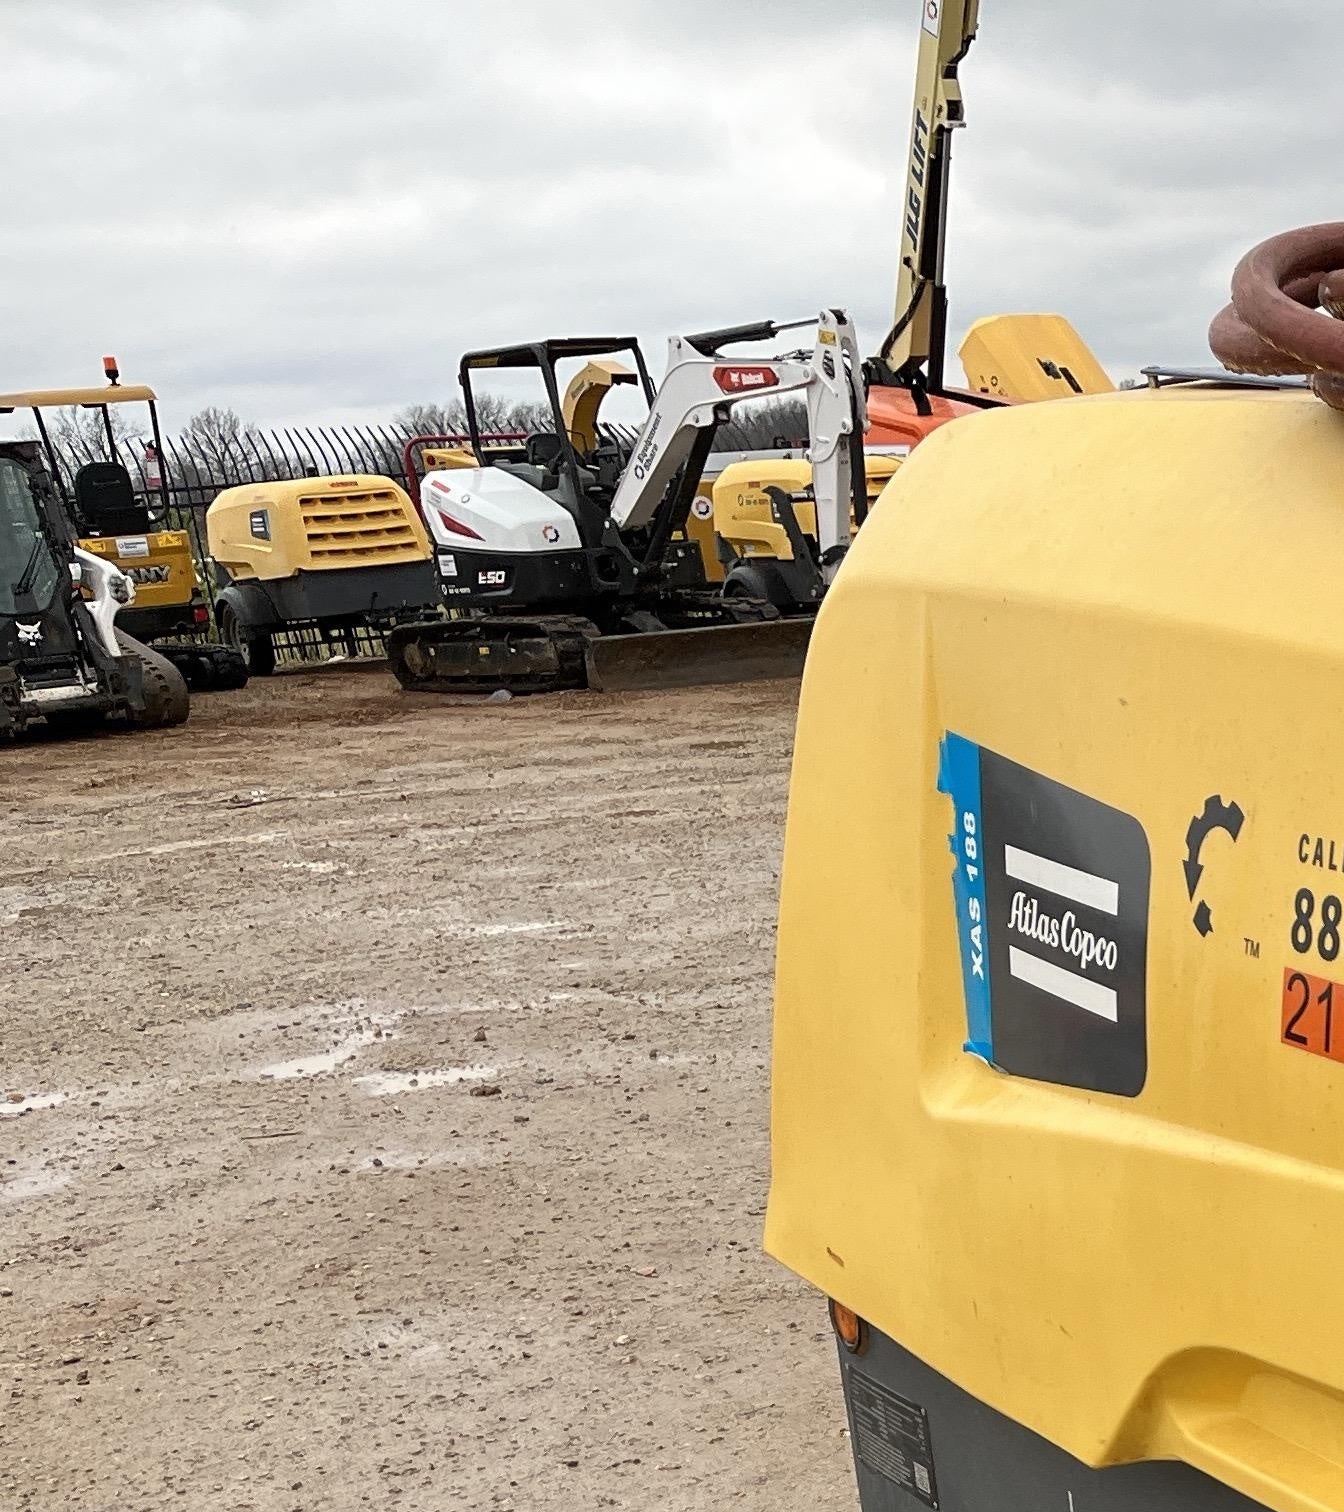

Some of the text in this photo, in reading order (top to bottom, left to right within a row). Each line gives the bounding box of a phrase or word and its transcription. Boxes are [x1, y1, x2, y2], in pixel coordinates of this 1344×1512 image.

[906, 108, 927, 253] JLG LIFT
[124, 564, 170, 583] ANY
[962, 811, 985, 981] XAS 188
[1007, 891, 1118, 971] Atlas Copco
